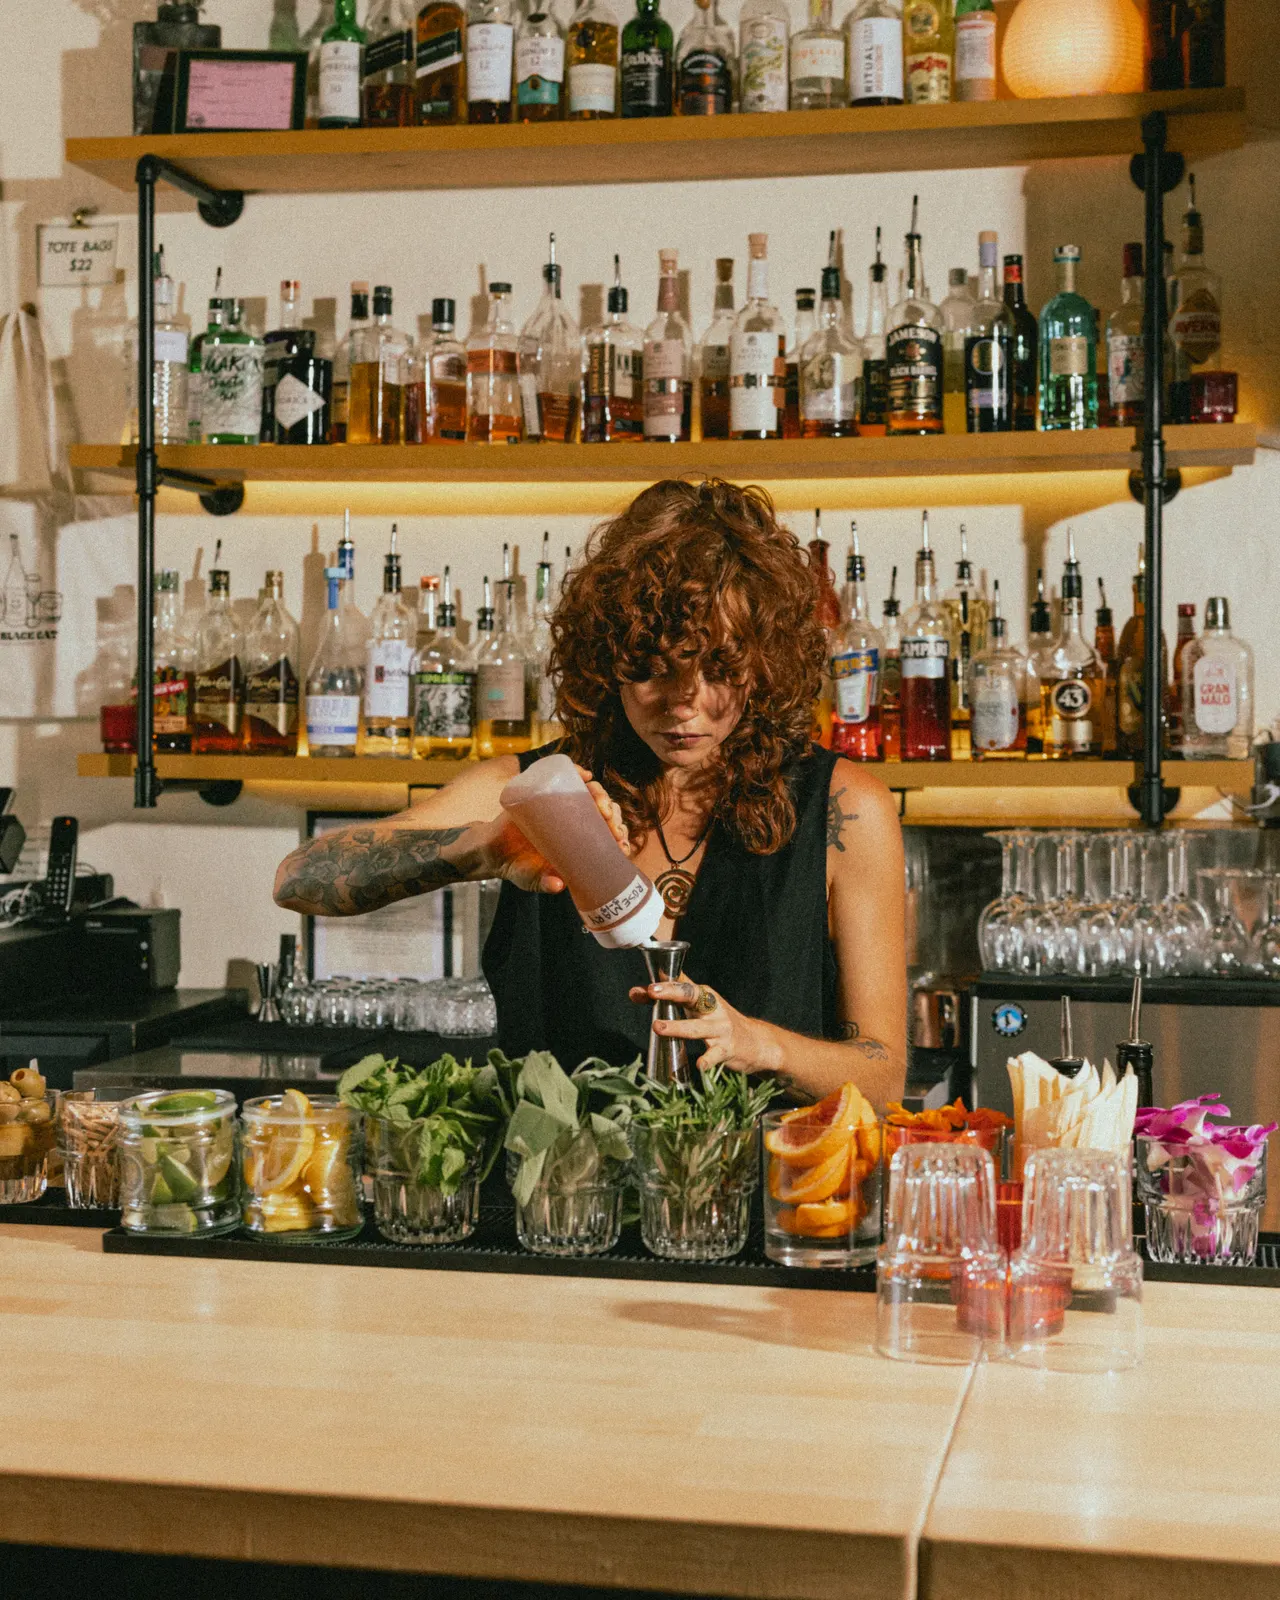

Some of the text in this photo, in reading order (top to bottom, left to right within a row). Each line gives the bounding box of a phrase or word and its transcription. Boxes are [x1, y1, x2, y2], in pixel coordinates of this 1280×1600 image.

[863, 46, 874, 93] RITUAL
[48, 240, 114, 253] TOTE BAGS
[69, 258, 93, 272] $22
[889, 326, 938, 347] JAMESON
[0, 630, 58, 640] BLACK CAT
[1200, 683, 1230, 694] GRAN
[1058, 688, 1084, 708] 43
[1201, 694, 1231, 705] MALO
